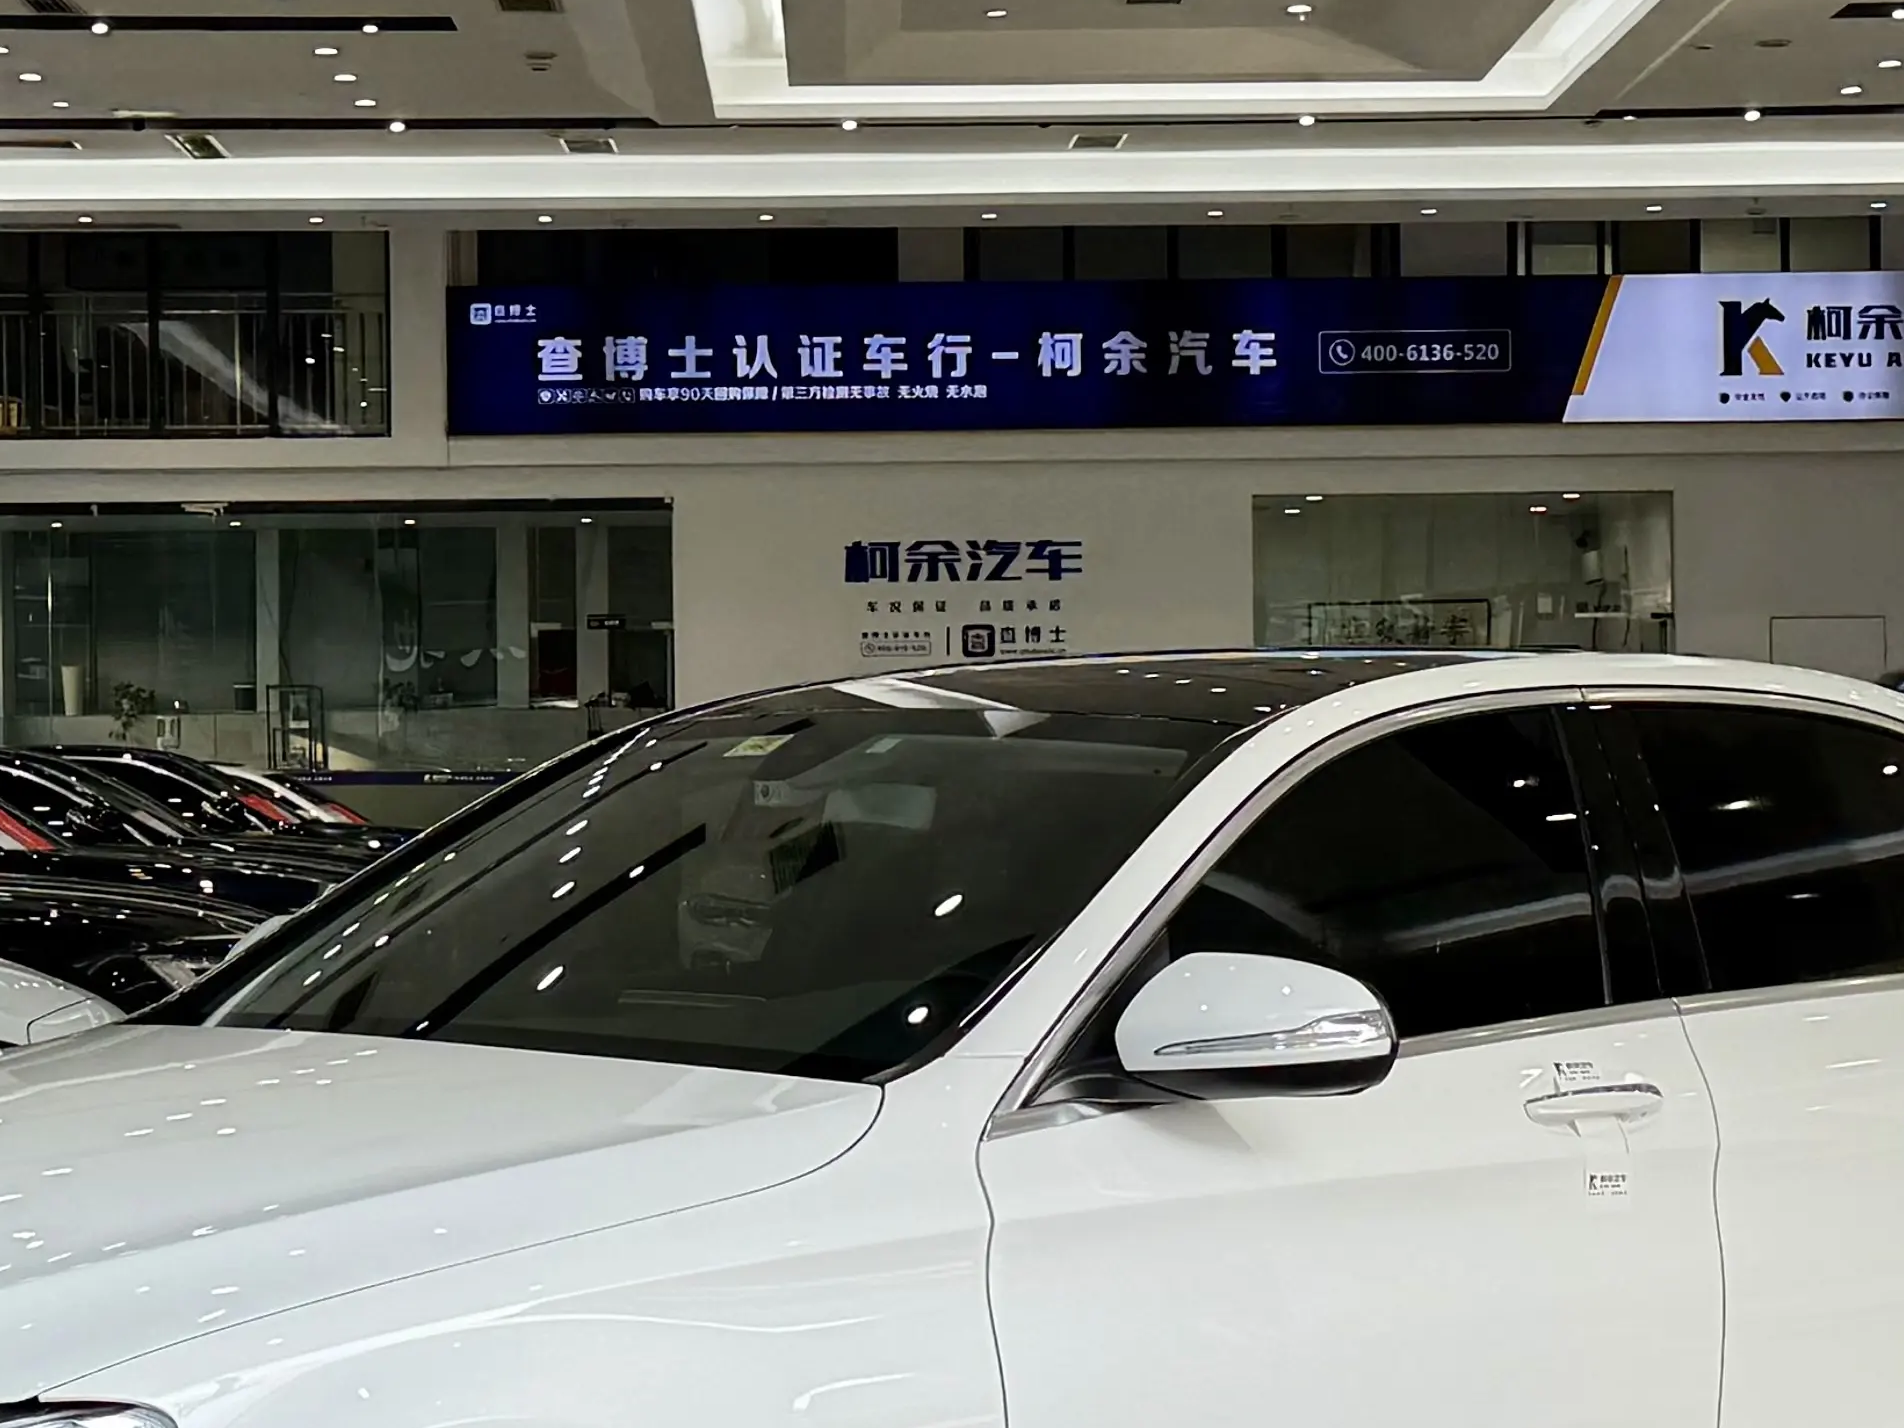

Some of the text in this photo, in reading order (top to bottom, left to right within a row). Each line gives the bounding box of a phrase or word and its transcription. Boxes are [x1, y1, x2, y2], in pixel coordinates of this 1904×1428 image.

[1361, 344, 1500, 362] 400-6136-520
[1806, 352, 1872, 368] KEYU
[844, 540, 1083, 583] 柯余汽车
